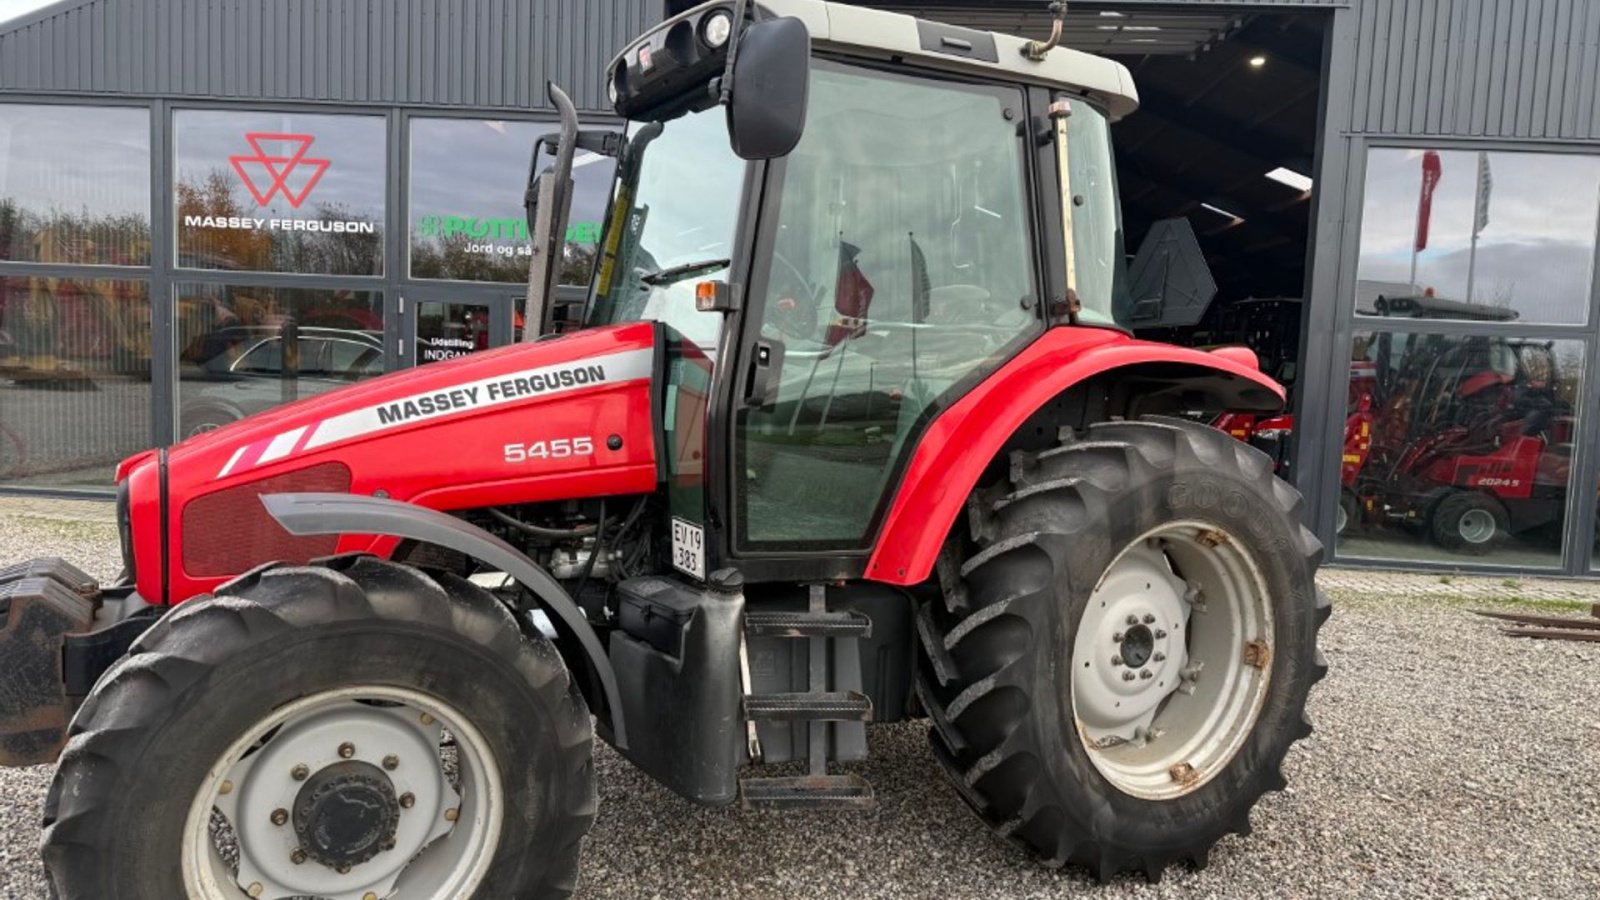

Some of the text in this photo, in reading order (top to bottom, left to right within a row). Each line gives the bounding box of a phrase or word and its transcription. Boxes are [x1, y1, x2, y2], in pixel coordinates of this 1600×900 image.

[184, 215, 375, 234] MASSEY FERGUSON
[464, 241, 493, 255] Jord
[497, 245, 514, 257] og
[377, 365, 606, 425] MASSEY FERGUSON
[504, 437, 594, 463] 5455
[679, 547, 697, 571] 383
